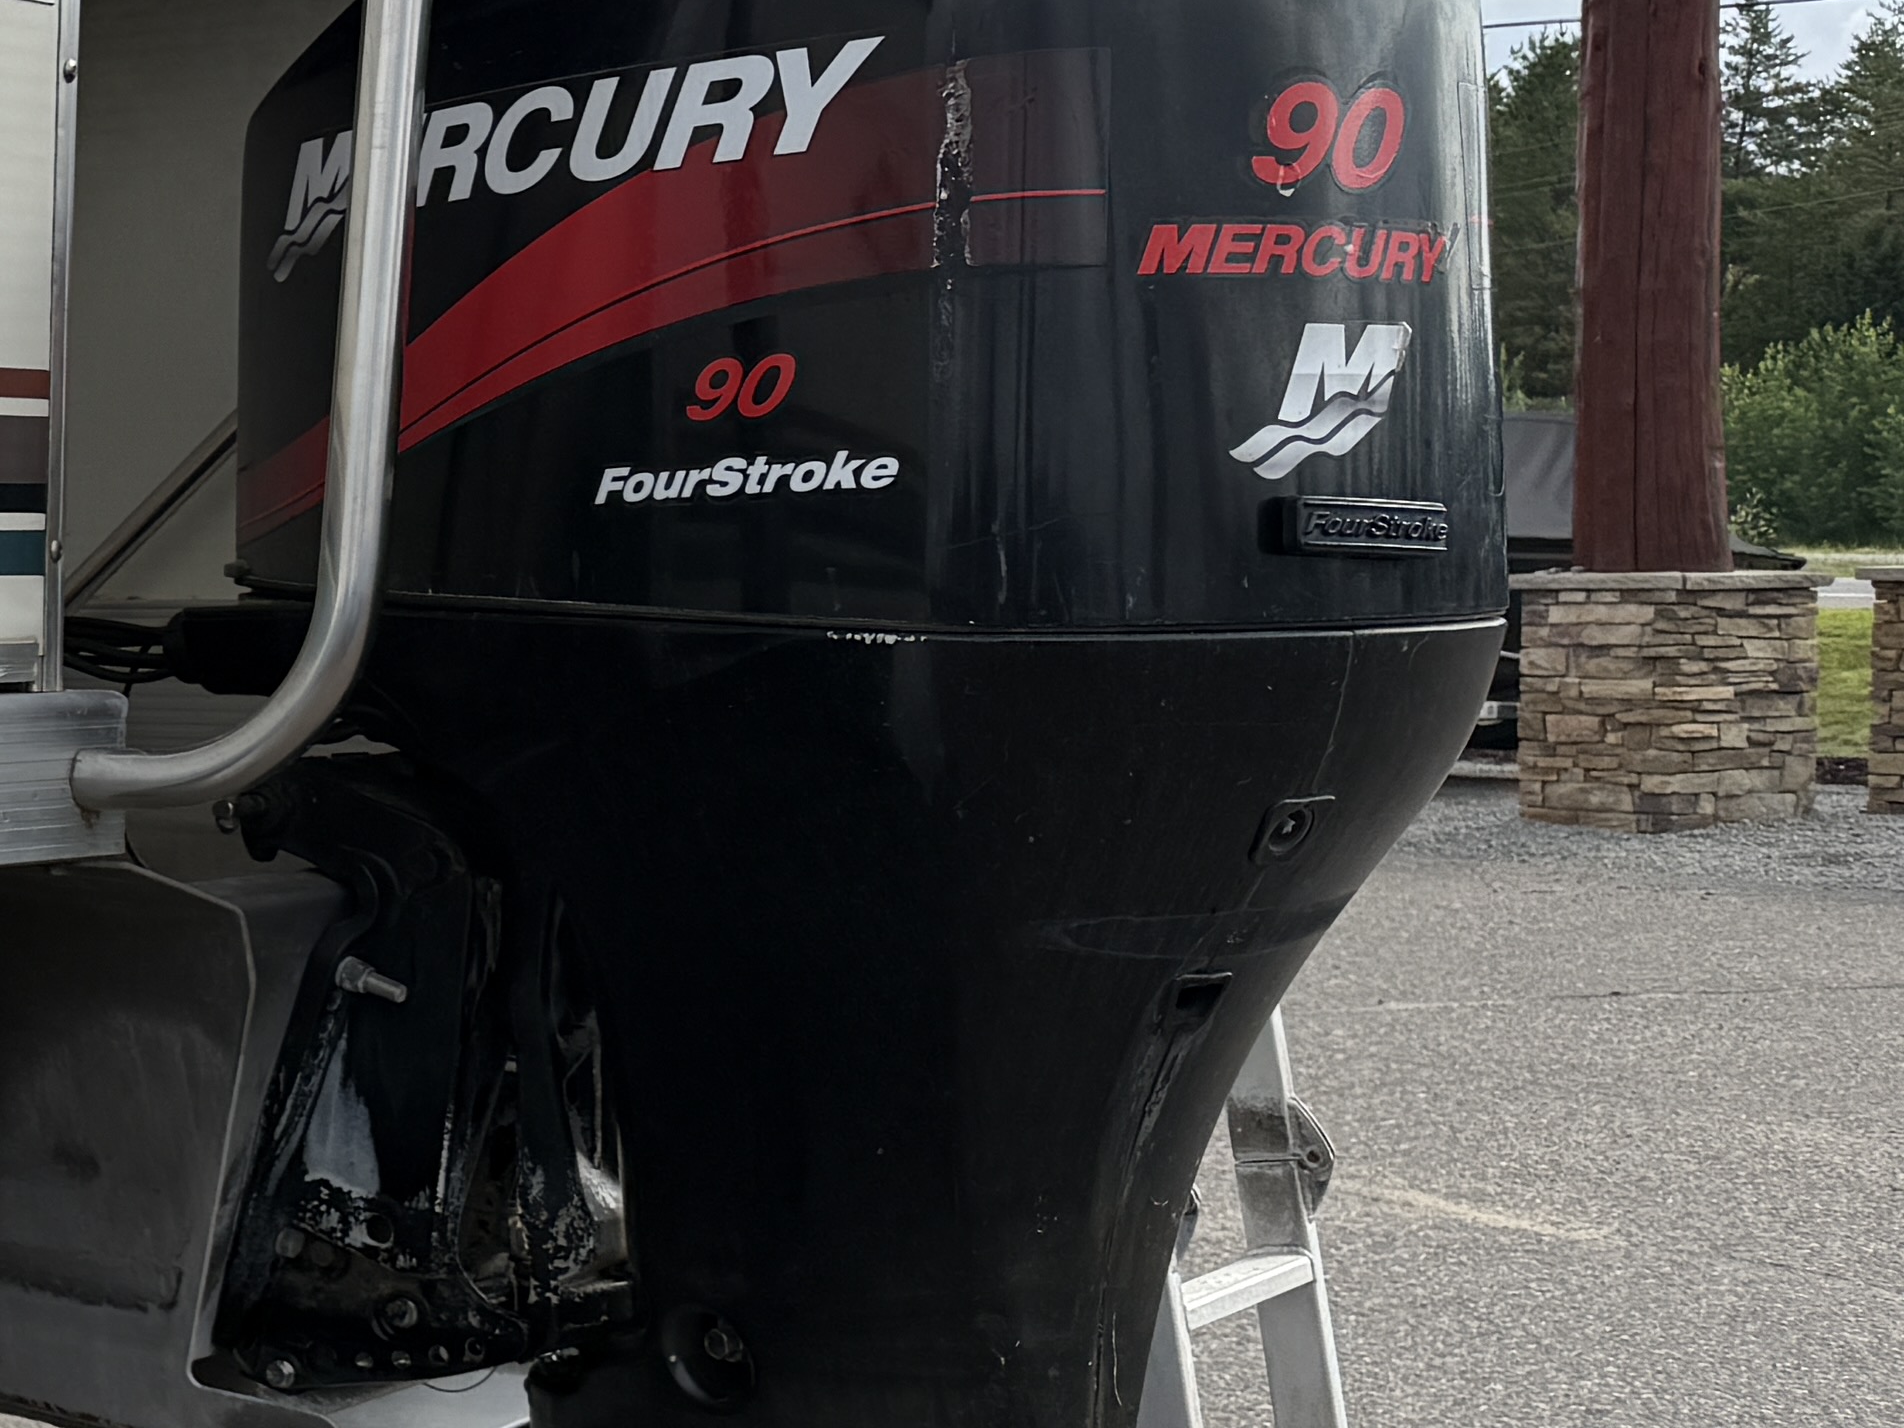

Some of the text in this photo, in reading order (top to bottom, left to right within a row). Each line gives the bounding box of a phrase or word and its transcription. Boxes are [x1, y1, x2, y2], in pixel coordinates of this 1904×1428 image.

[284, 36, 885, 232] MRCURY
[1252, 82, 1404, 189] 90
[1137, 223, 1454, 283] MERCURY
[686, 353, 797, 421] 90
[594, 450, 899, 505] FourStroke
[1304, 510, 1449, 543] FourStroke
